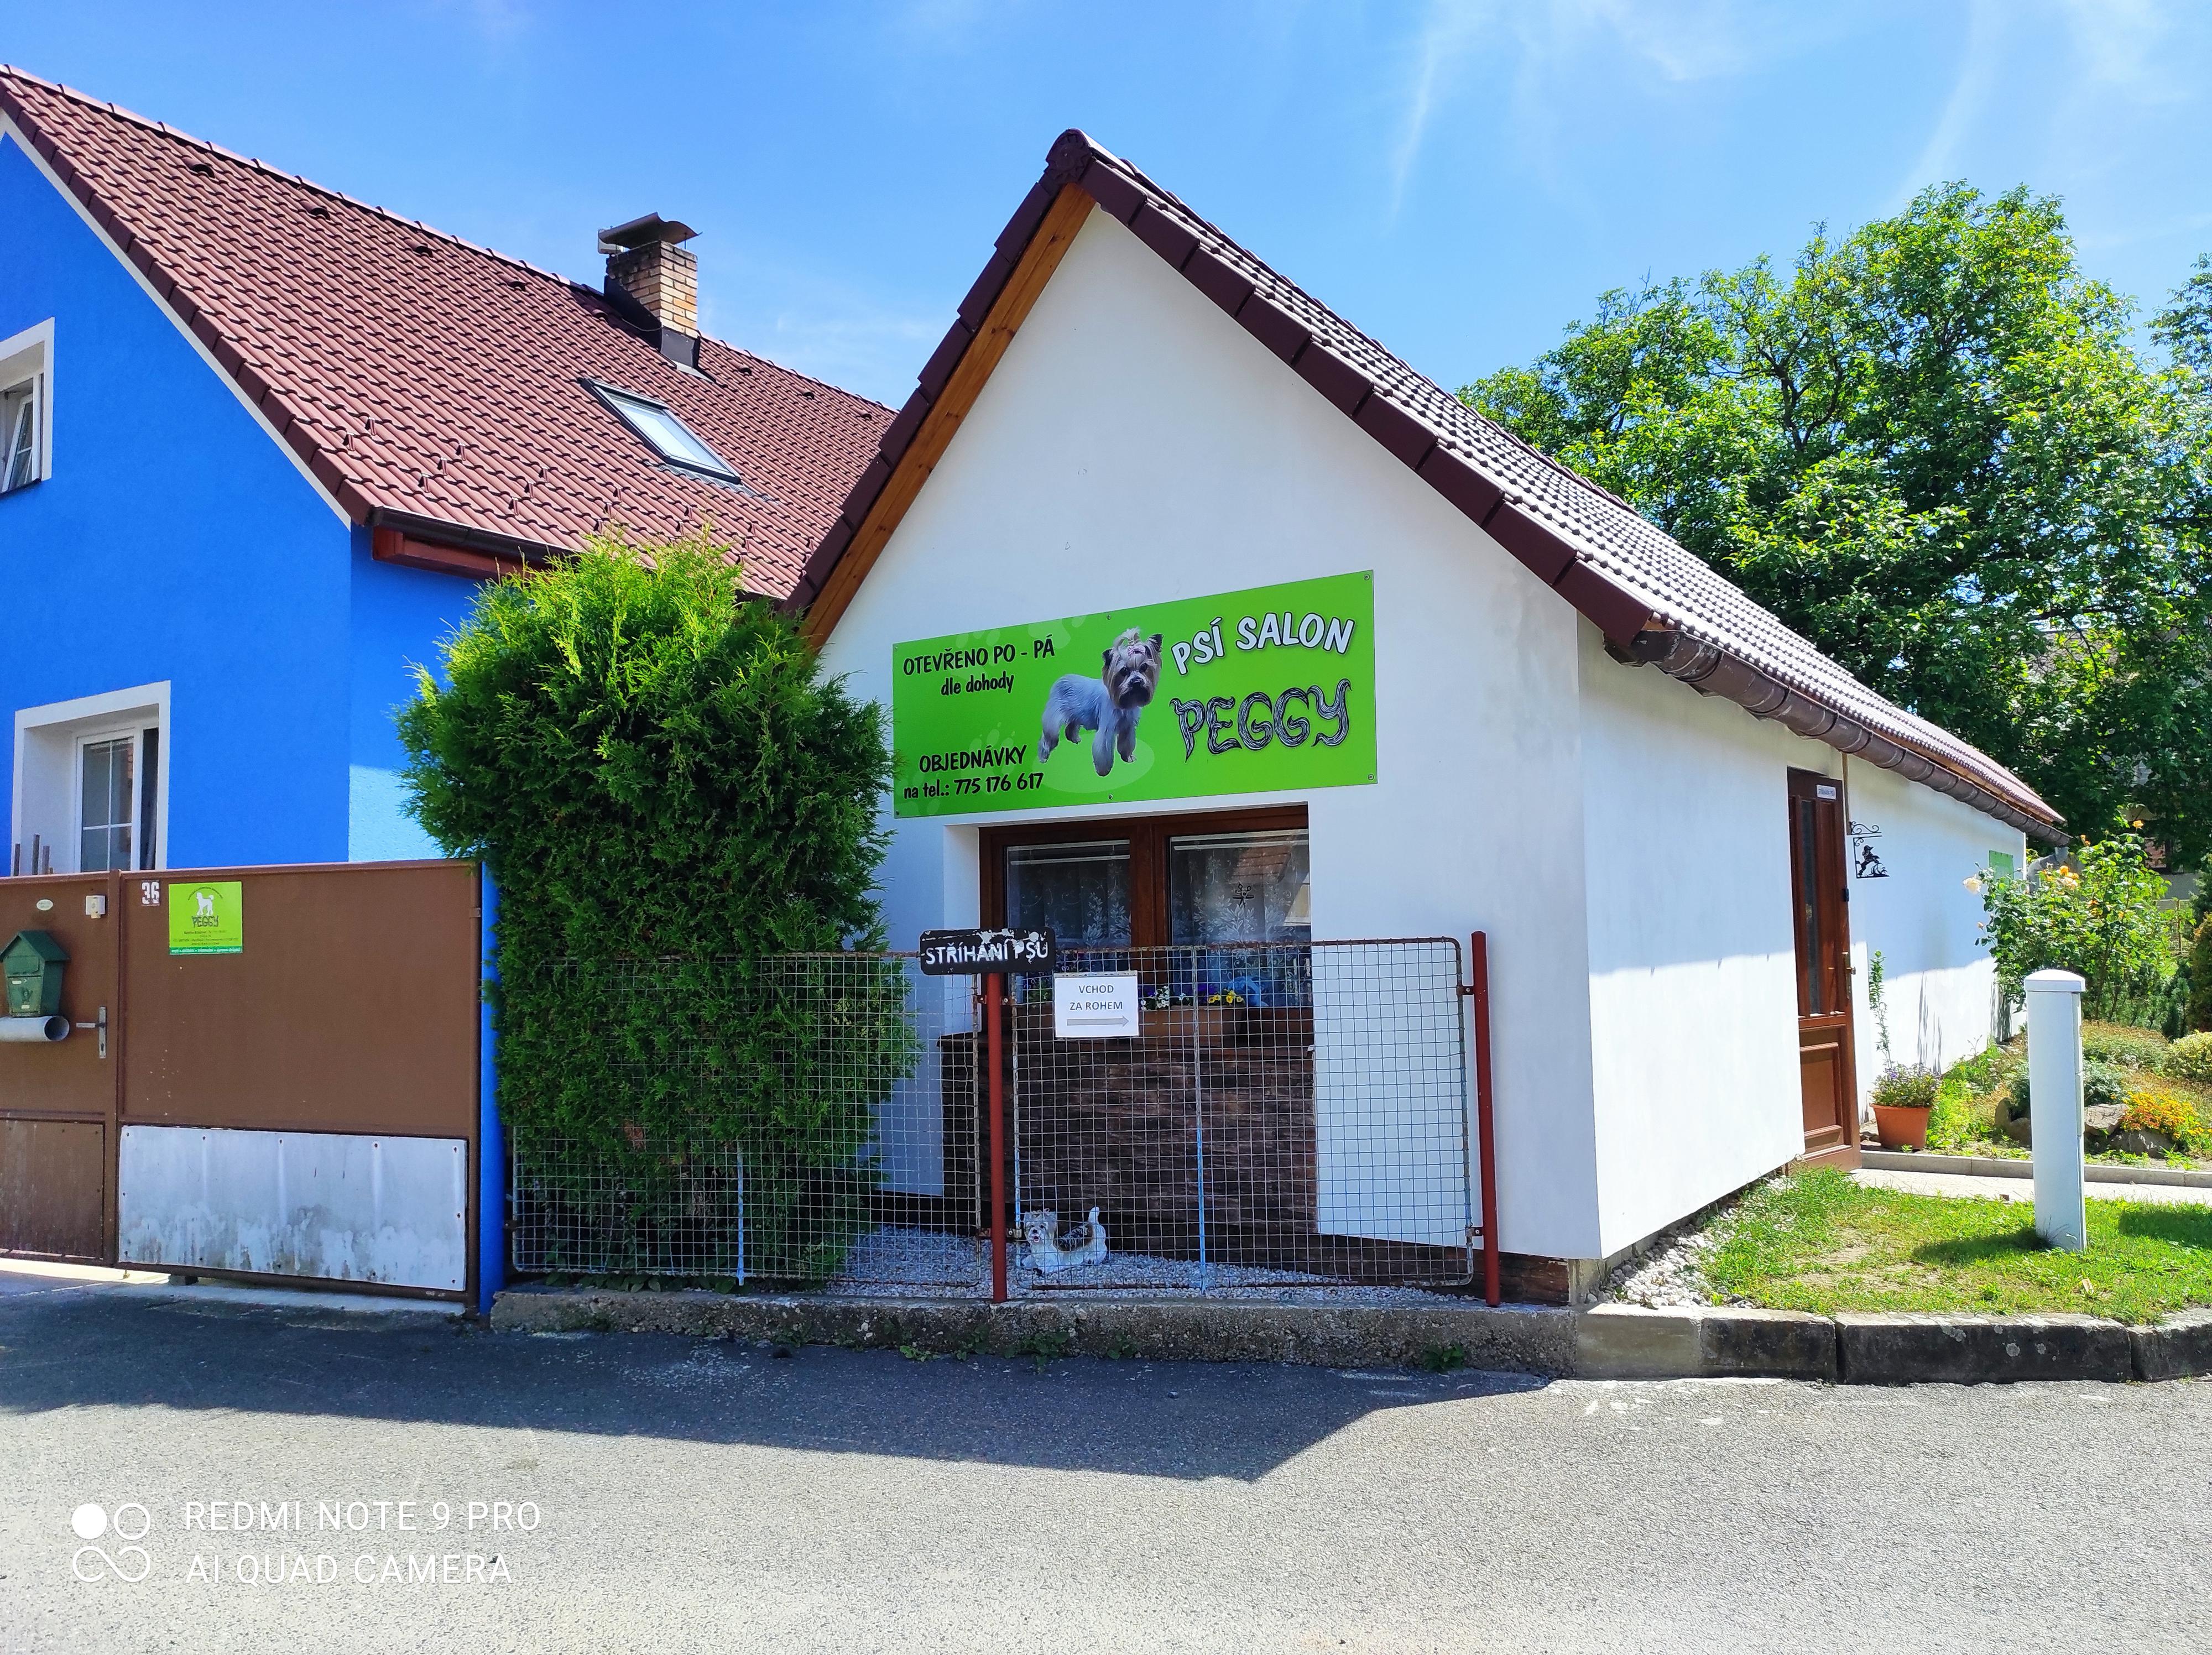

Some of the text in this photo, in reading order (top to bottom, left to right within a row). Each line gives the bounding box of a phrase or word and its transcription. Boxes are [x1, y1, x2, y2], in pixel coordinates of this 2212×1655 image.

[904, 648, 988, 675] OTEVŘENO
[994, 644, 1015, 664] PO
[1034, 634, 1055, 658] PÁ
[1171, 612, 1355, 675] PSÍ SALON
[941, 670, 1014, 696] dle dohody
[1169, 678, 1353, 763] PEGGY
[919, 744, 1027, 772] OBJEDNÁVKY
[904, 772, 1044, 799] na tel.: 775 176 617
[142, 881, 160, 905] 36
[191, 915, 219, 928] PEGGY
[1078, 985, 1114, 994] VCHOD
[1070, 1001, 1123, 1010] ZA ROHEM
